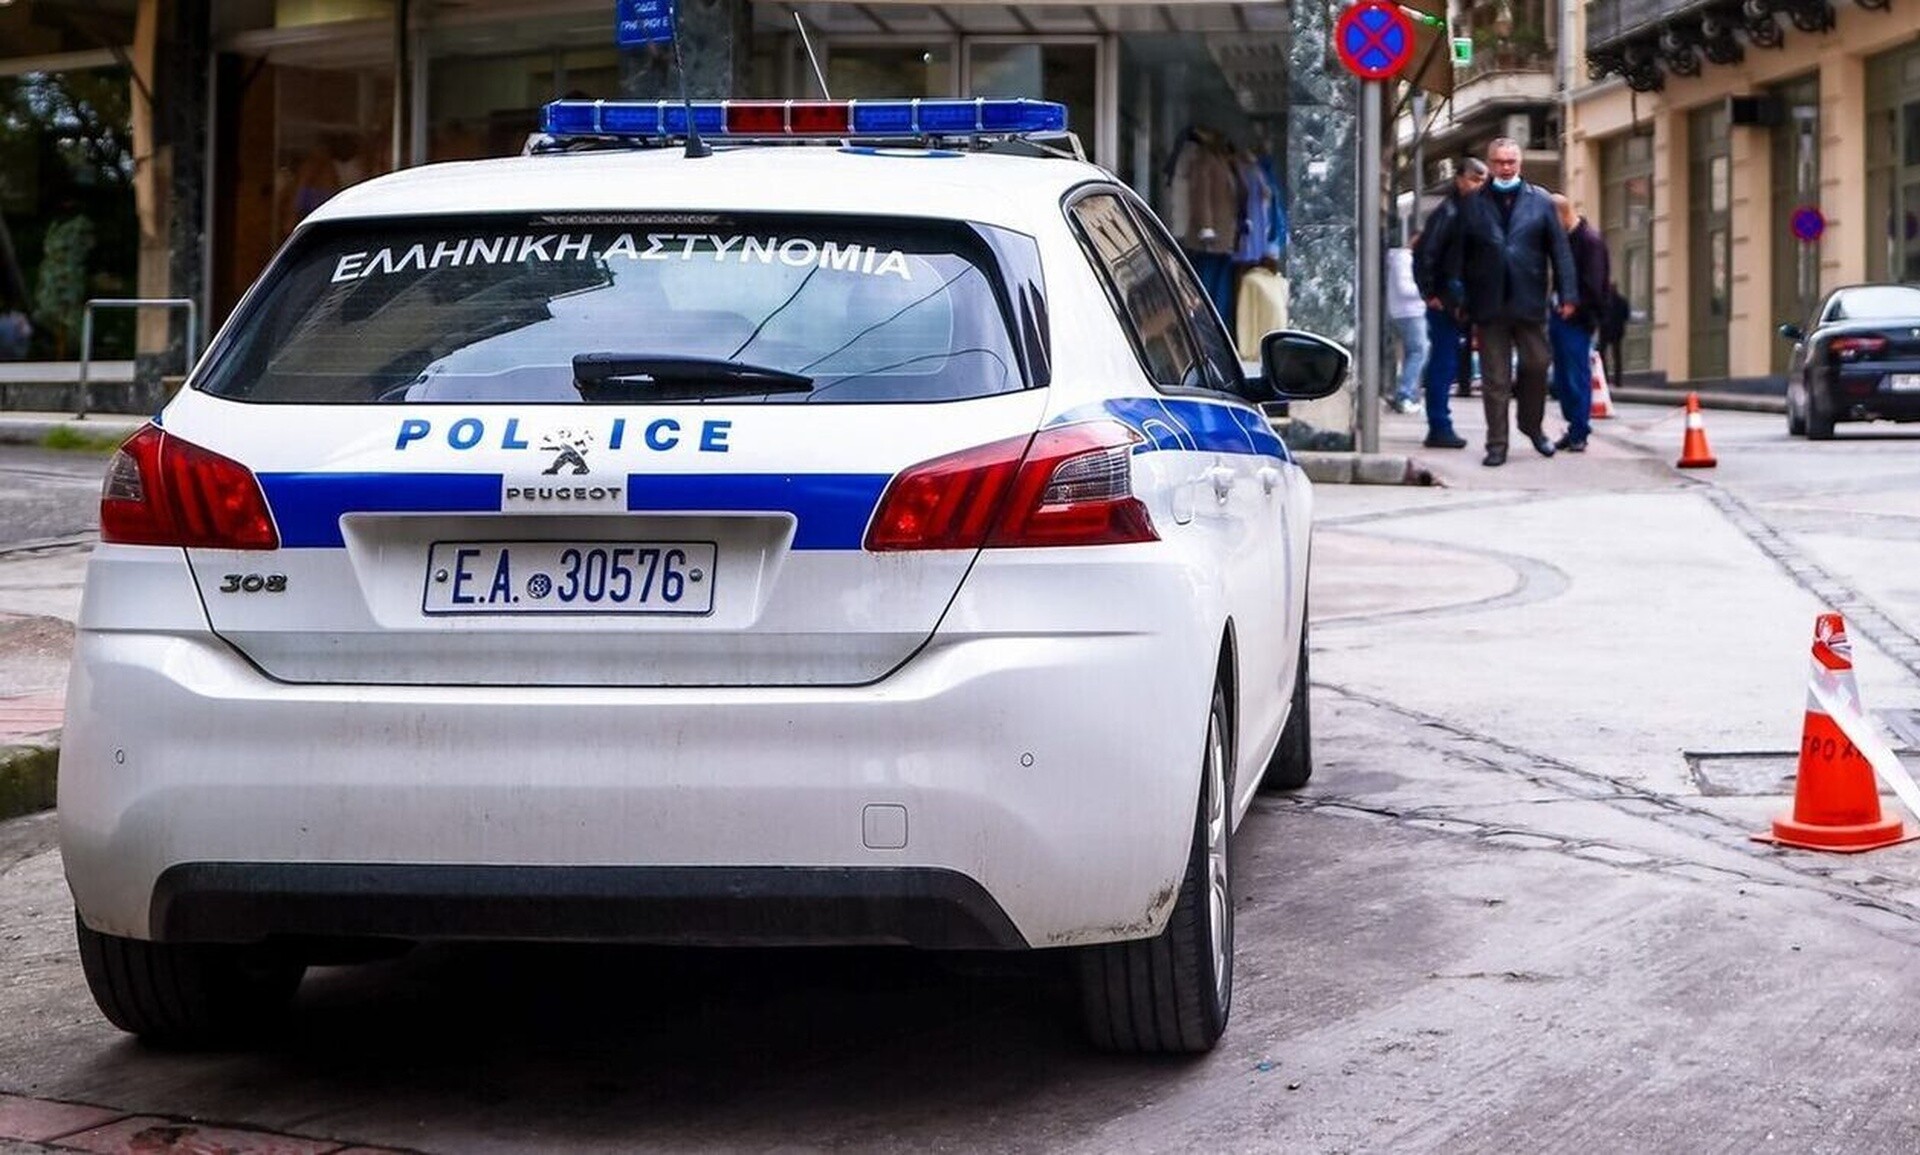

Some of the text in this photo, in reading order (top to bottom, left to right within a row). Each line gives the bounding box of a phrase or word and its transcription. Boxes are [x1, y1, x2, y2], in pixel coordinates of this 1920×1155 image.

[331, 233, 913, 284] ΕΛΛΗΝΙΚΗ ΑΣΤΥΝΟΜΙΑ
[395, 417, 732, 453] POLICE
[506, 487, 622, 500] PEUGEOT
[219, 573, 288, 593] 308
[557, 549, 687, 603] 30576
